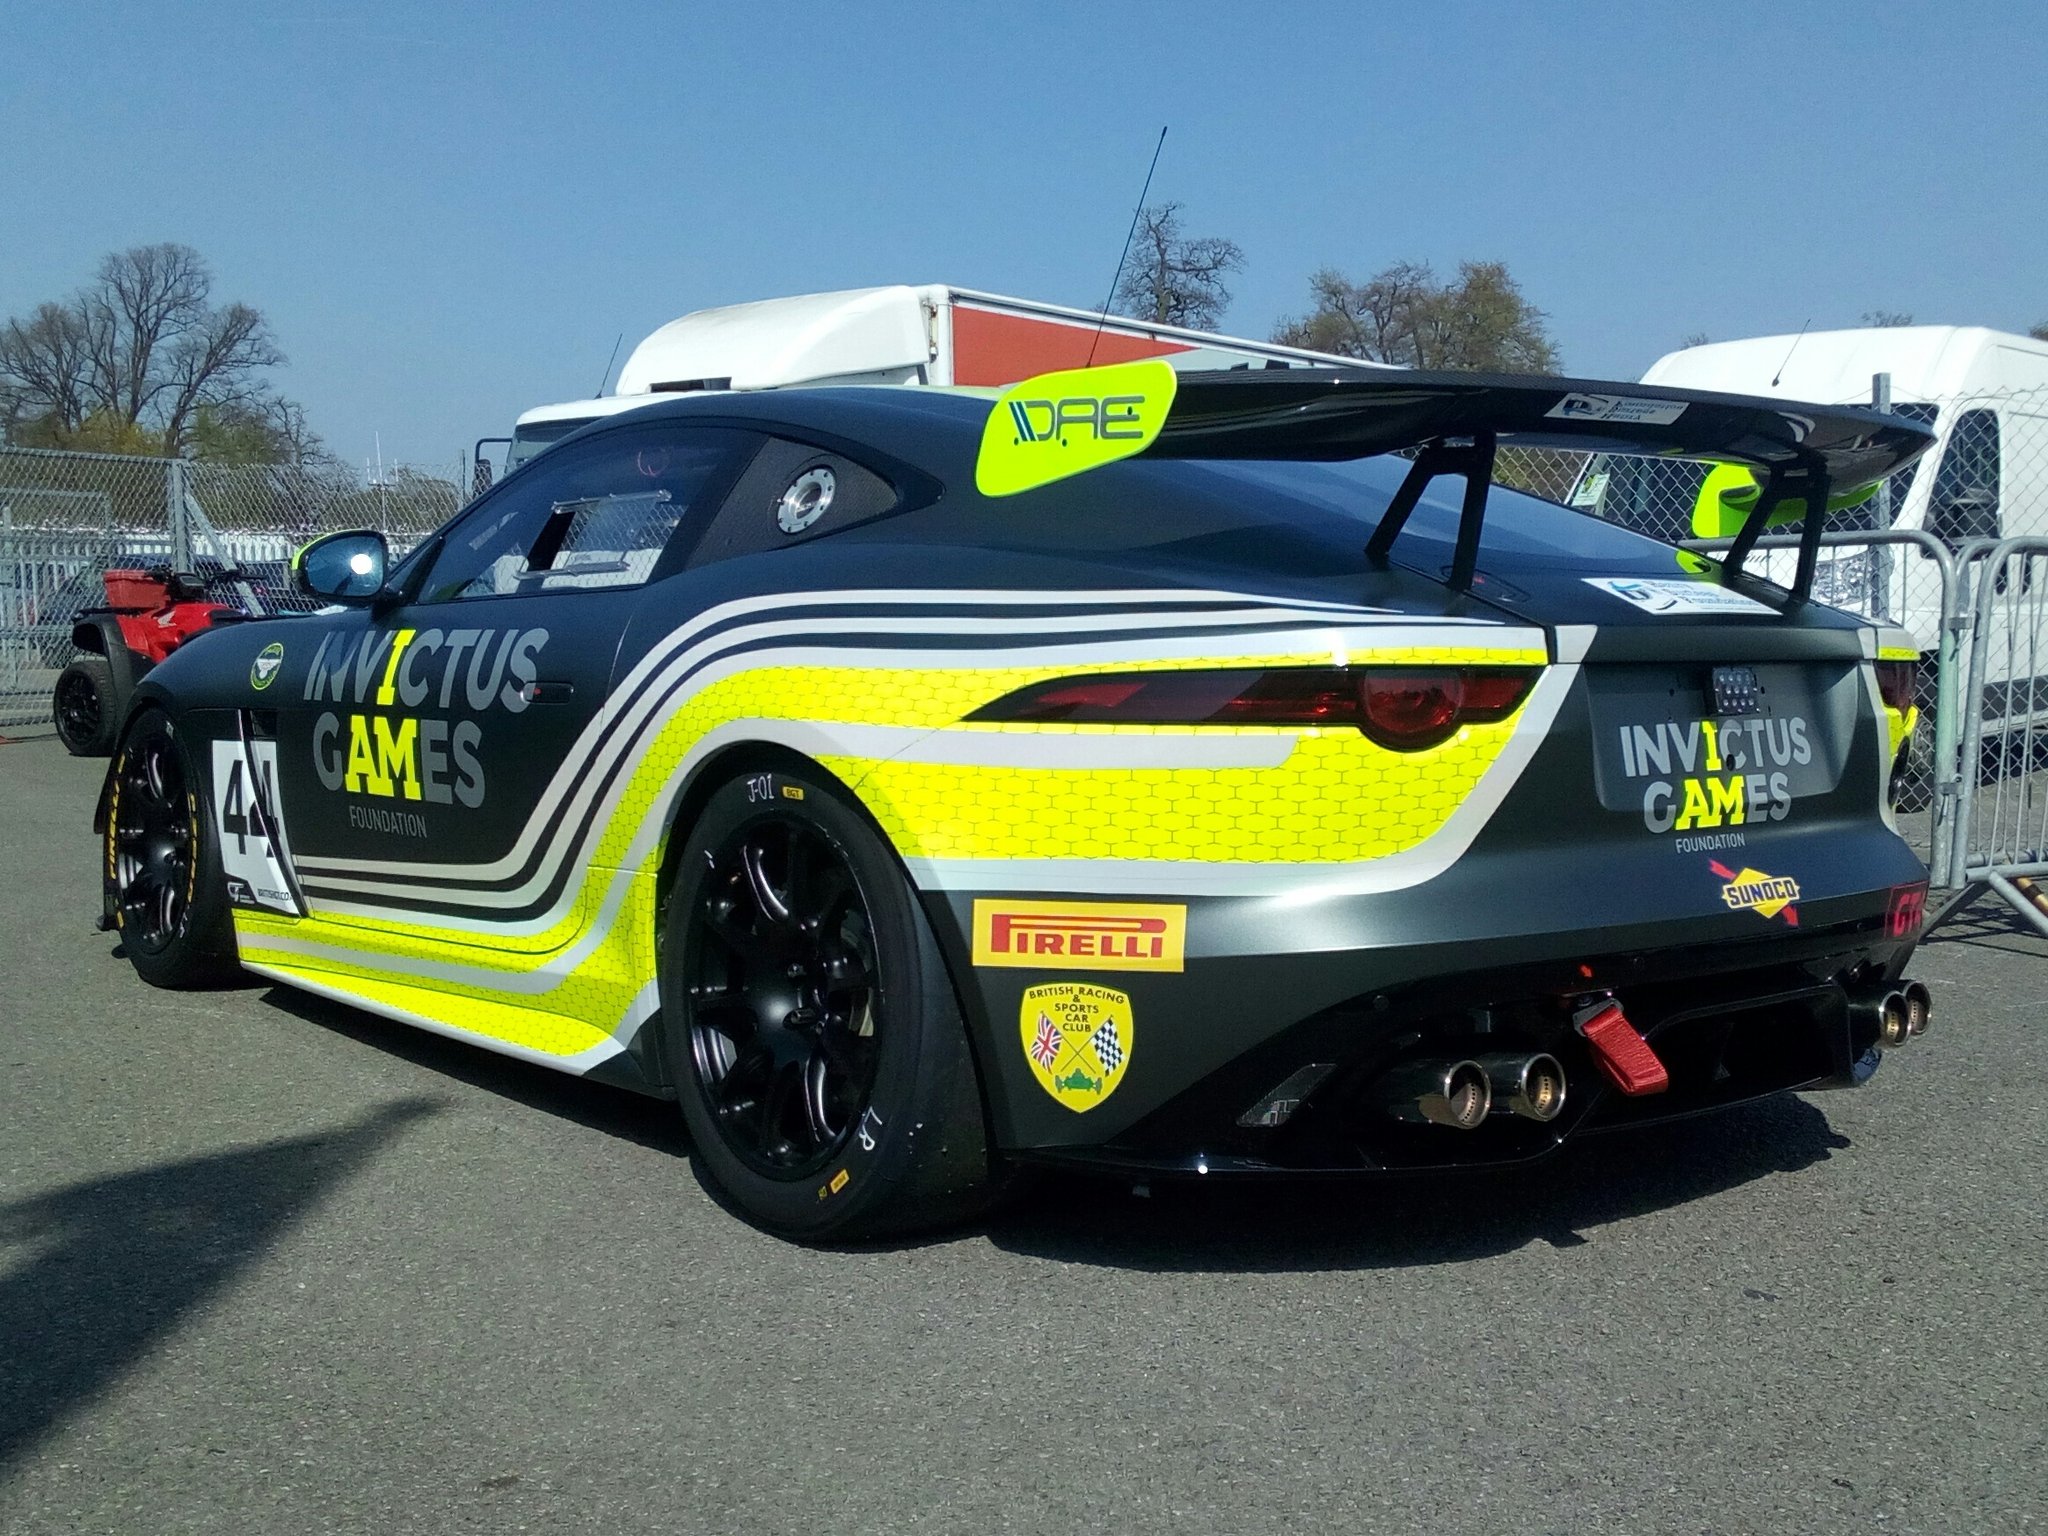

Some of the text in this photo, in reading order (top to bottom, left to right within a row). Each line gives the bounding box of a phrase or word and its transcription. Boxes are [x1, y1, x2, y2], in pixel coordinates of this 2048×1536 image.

[1009, 396, 1145, 442] DAE
[303, 628, 550, 713] INVICTUS
[313, 711, 486, 808] GAMES
[1619, 716, 1812, 777] INVICTUS
[1643, 771, 1792, 834] GAMES
[350, 804, 427, 838] FOUNDATION
[1675, 832, 1746, 854] FOUNDATION
[1728, 879, 1796, 905] SUNOCO
[991, 914, 1166, 958] PIRELLI
[1028, 986, 1125, 1005] BRITISH RACING
[1054, 1003, 1099, 1014] SPORTS
[1073, 994, 1081, 1003] &
[1062, 1023, 1092, 1033] CLUB
[1065, 1013, 1089, 1023] CAR
